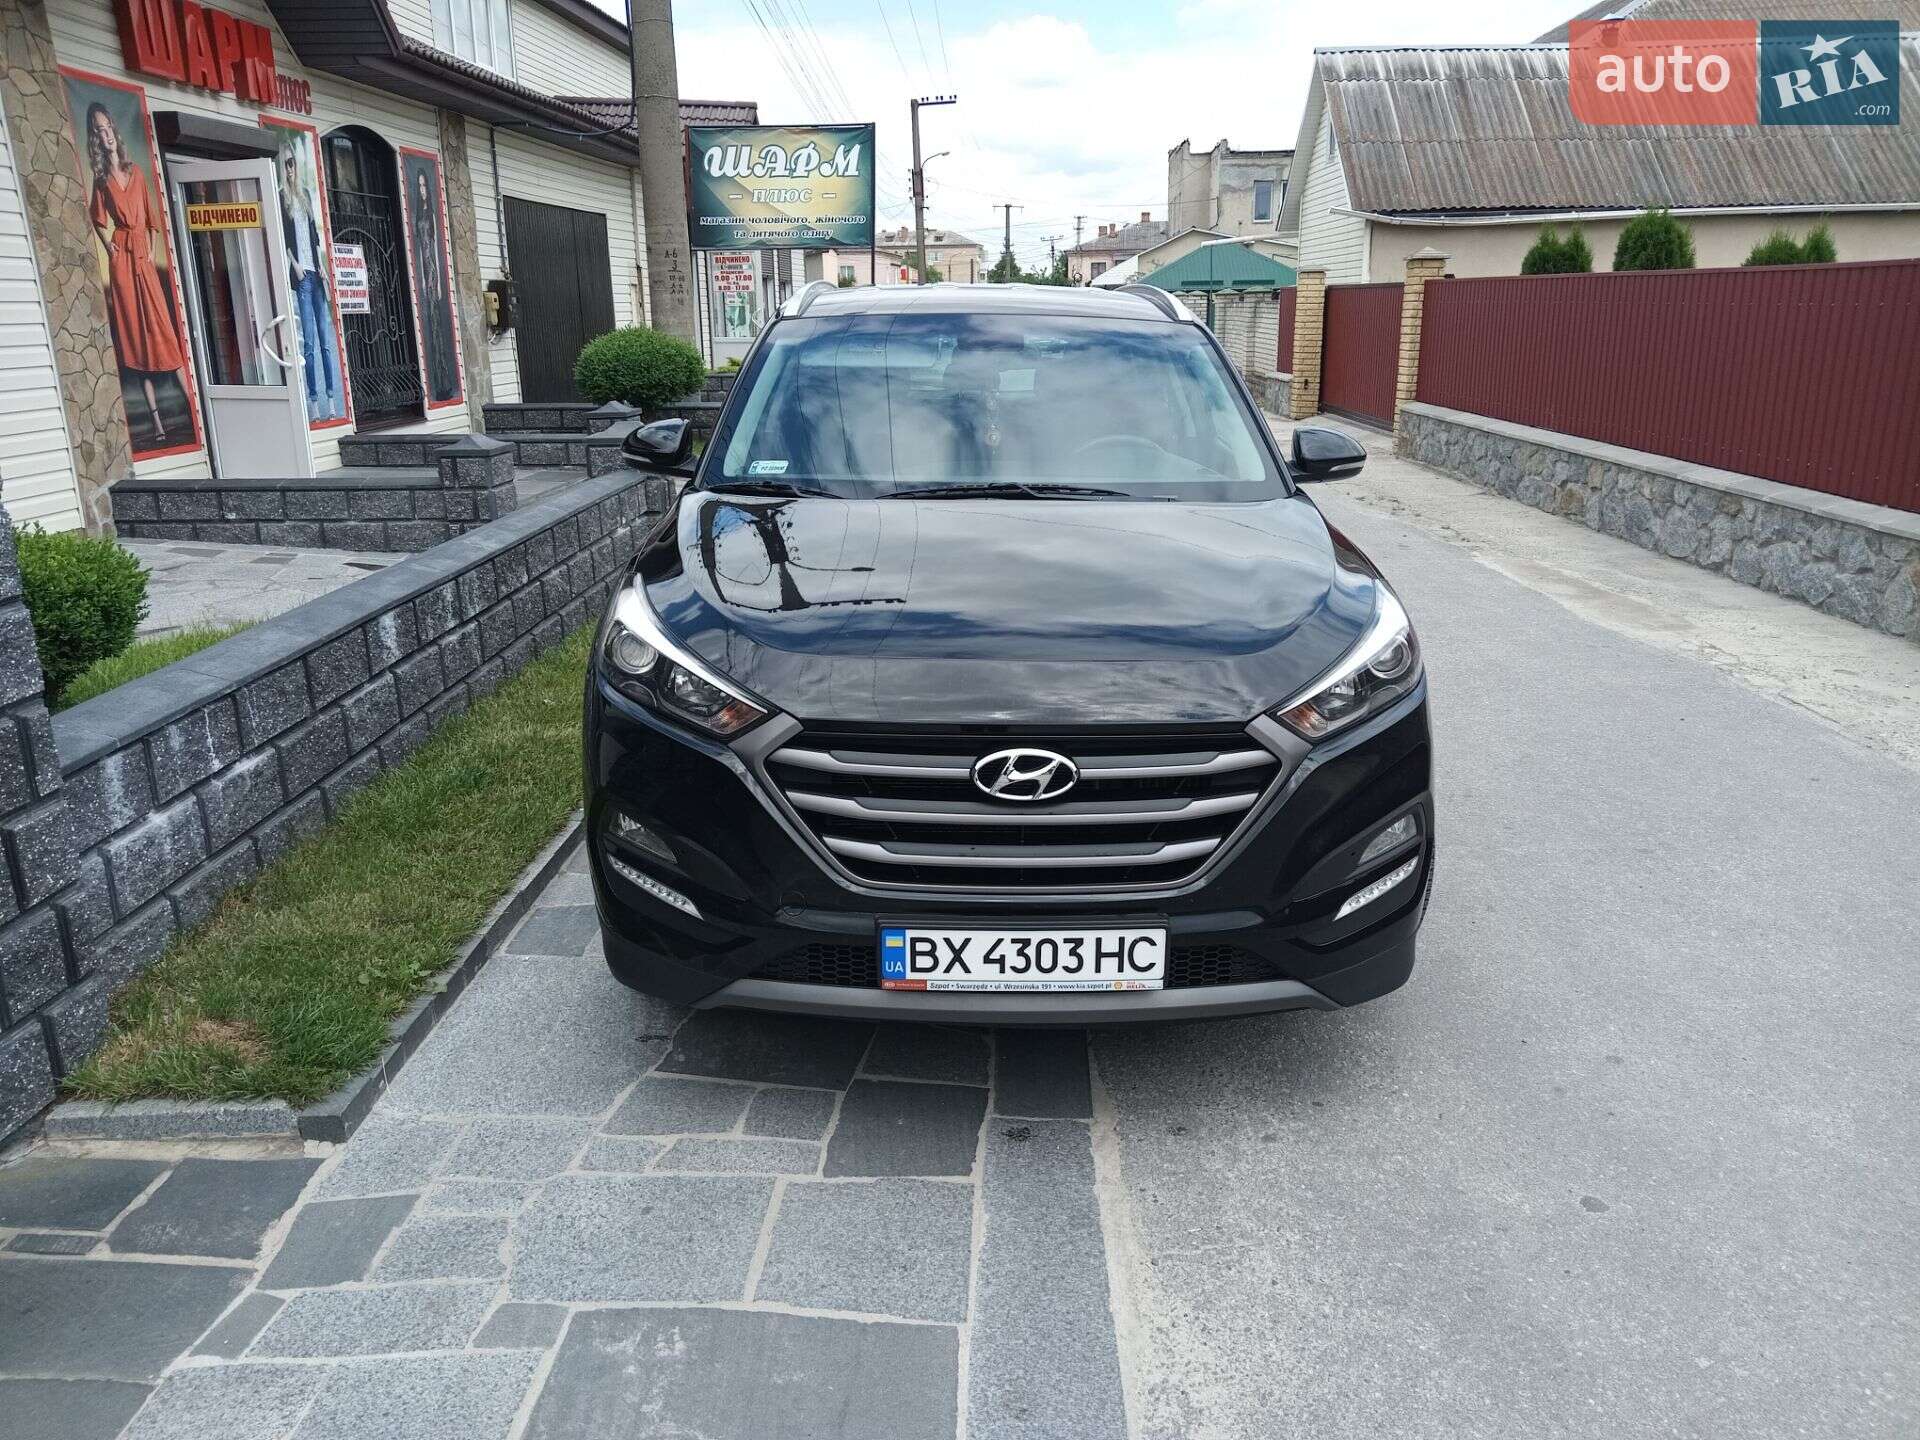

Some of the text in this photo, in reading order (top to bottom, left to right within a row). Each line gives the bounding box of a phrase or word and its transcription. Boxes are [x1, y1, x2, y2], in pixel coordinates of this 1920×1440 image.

[113, 0, 275, 103] ШАРМ
[703, 142, 862, 178] ШАРМ
[189, 207, 258, 227] ВІДЧИНЕНО
[814, 215, 867, 225] жіночого
[714, 255, 751, 265] ВІДЧИНЕНО
[909, 936, 1158, 974] BX 4303 HC
[885, 961, 904, 973] UA
